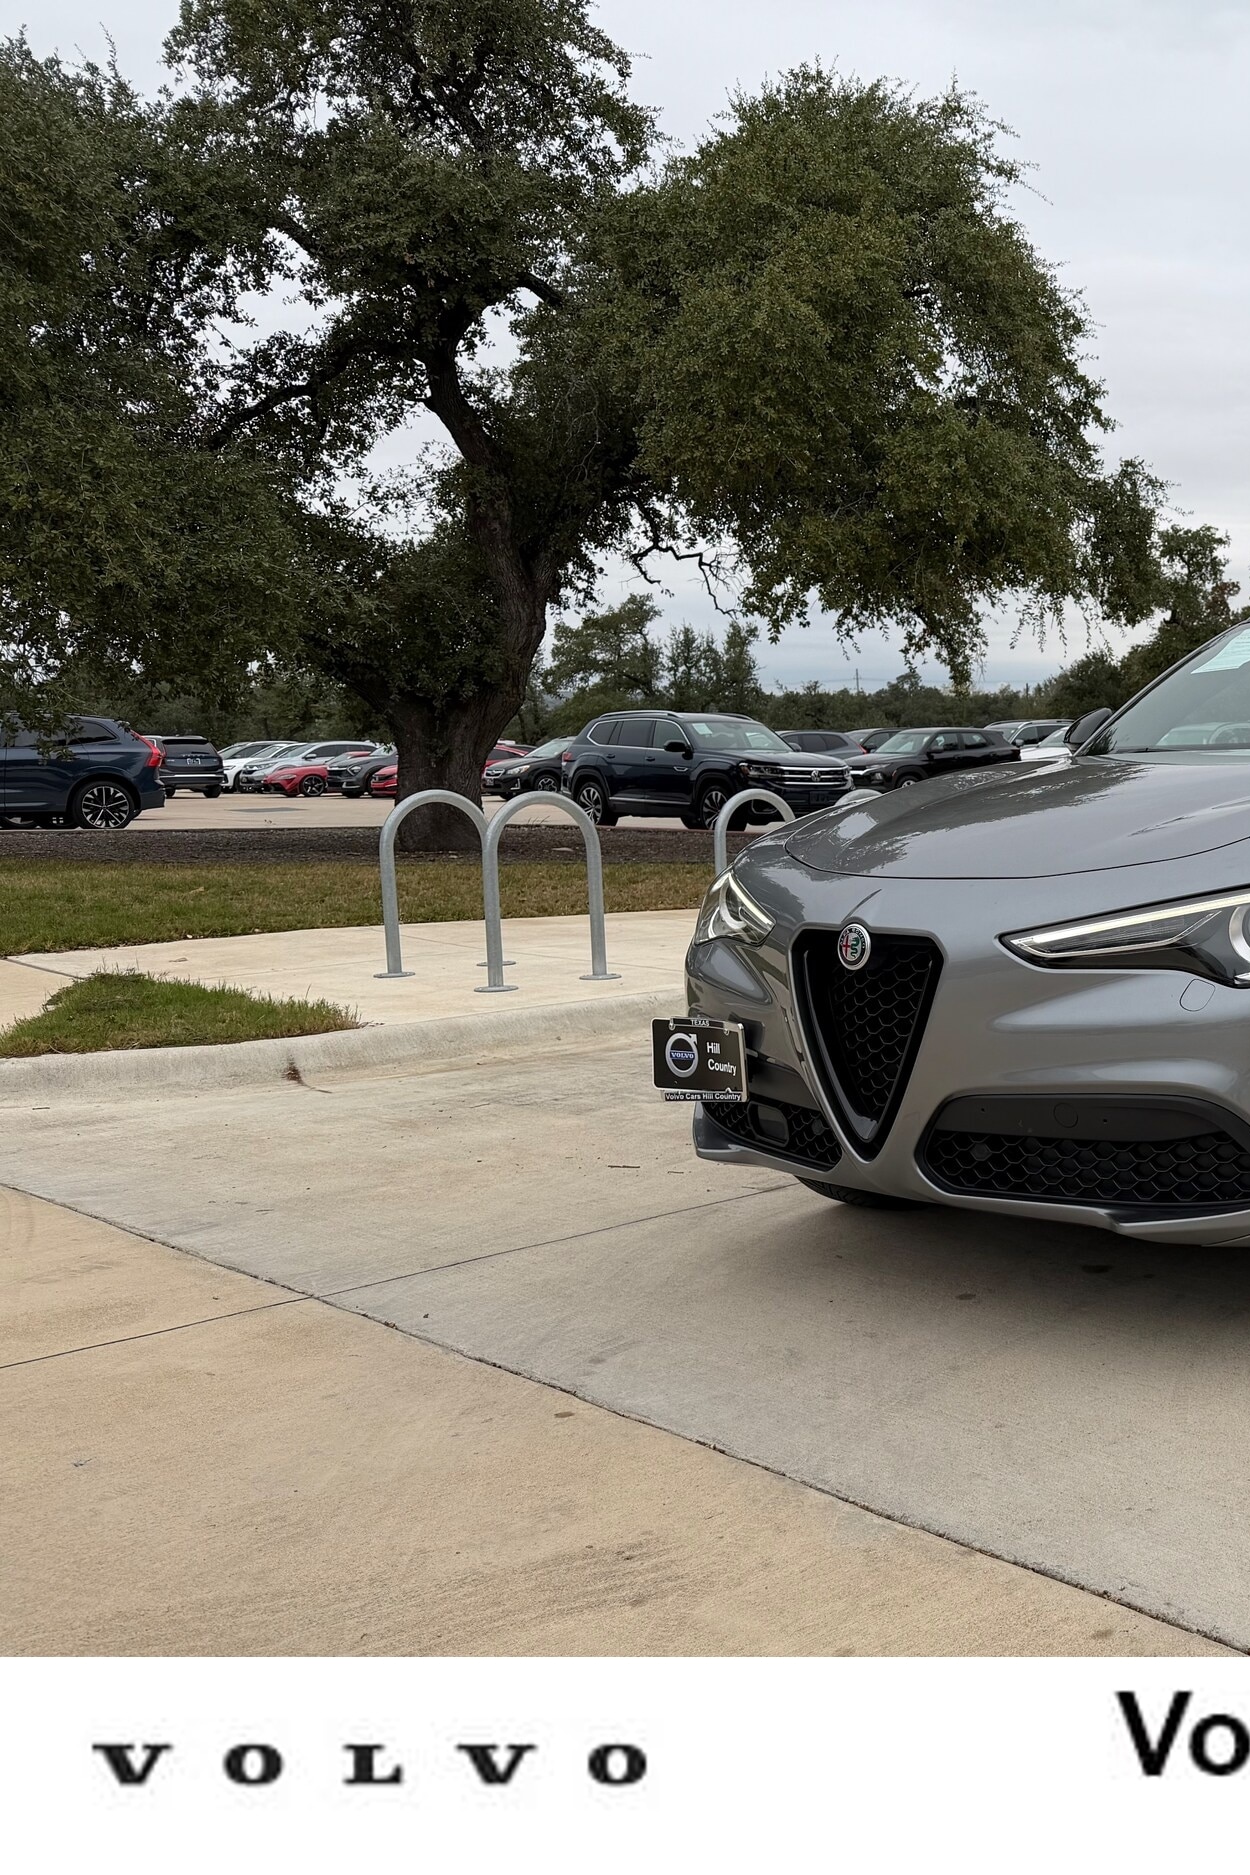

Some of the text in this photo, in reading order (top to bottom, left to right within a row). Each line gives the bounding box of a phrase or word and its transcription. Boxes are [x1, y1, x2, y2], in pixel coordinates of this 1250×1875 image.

[690, 1019, 710, 1027] TEXAS
[706, 1042, 720, 1054] Hill
[707, 1059, 737, 1076] Country
[665, 1092, 684, 1100] Volvo
[714, 1093, 741, 1101] Country
